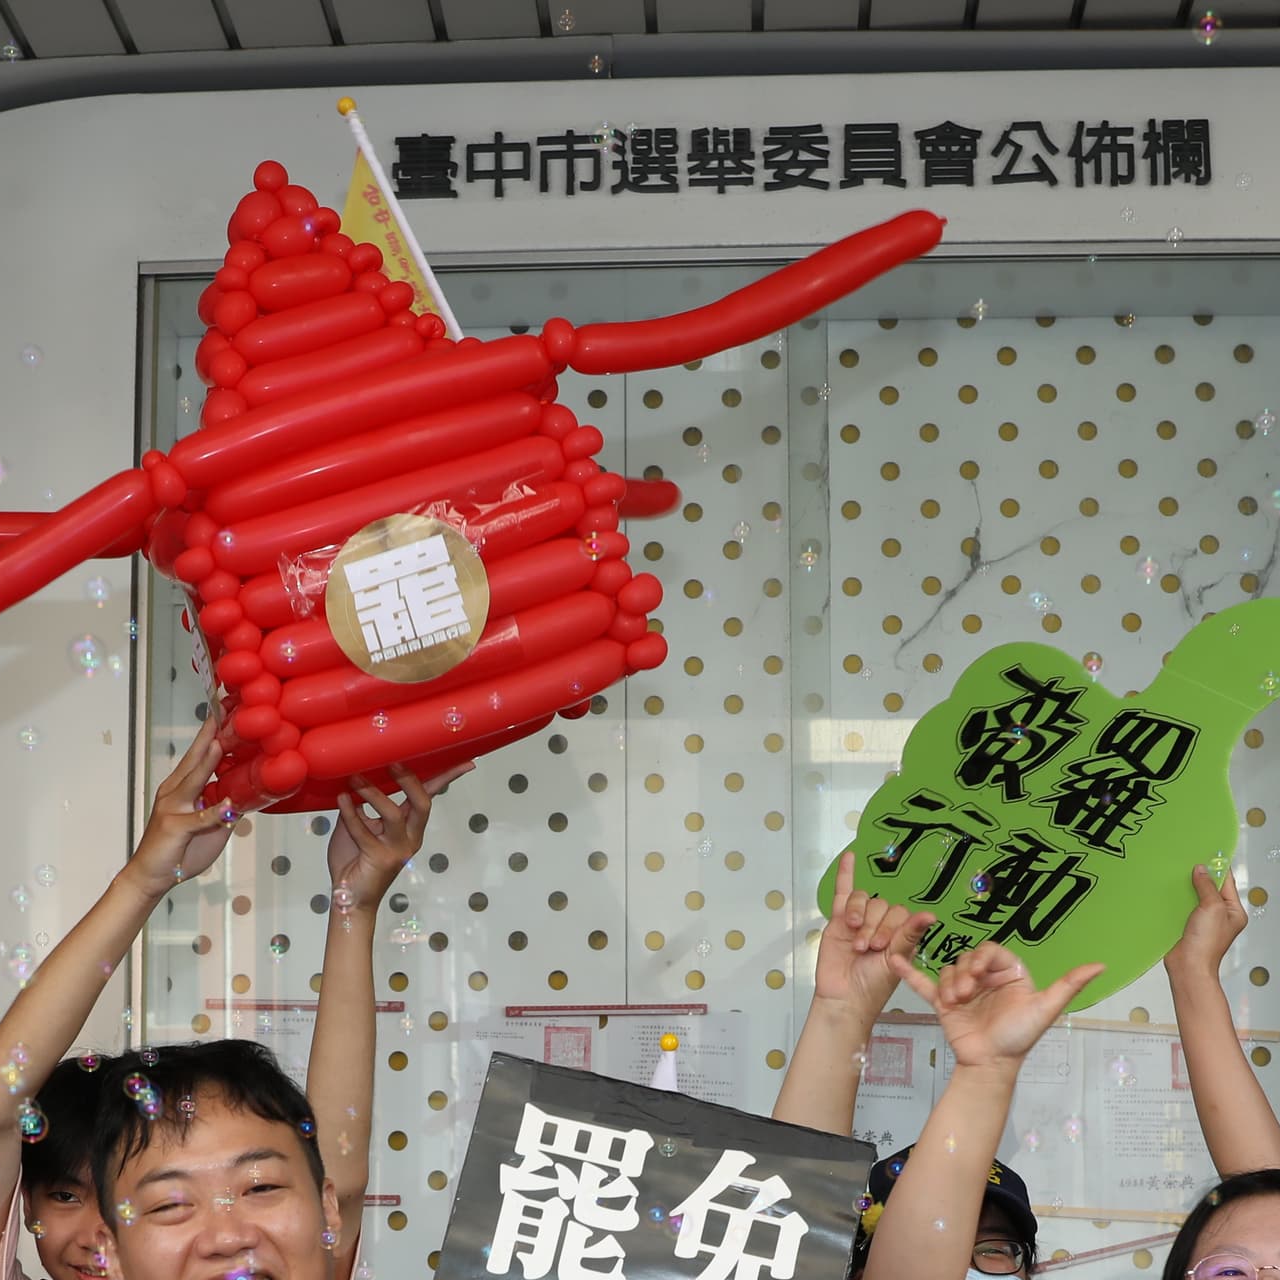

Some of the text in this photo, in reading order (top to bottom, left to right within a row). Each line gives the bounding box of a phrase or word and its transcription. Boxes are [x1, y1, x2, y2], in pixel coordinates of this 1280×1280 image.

[390, 118, 1213, 198] 臺中市選舉委員會公佈欄
[343, 534, 469, 653] 罷
[954, 663, 1201, 858] 敲羅
[868, 789, 1098, 946] 行動
